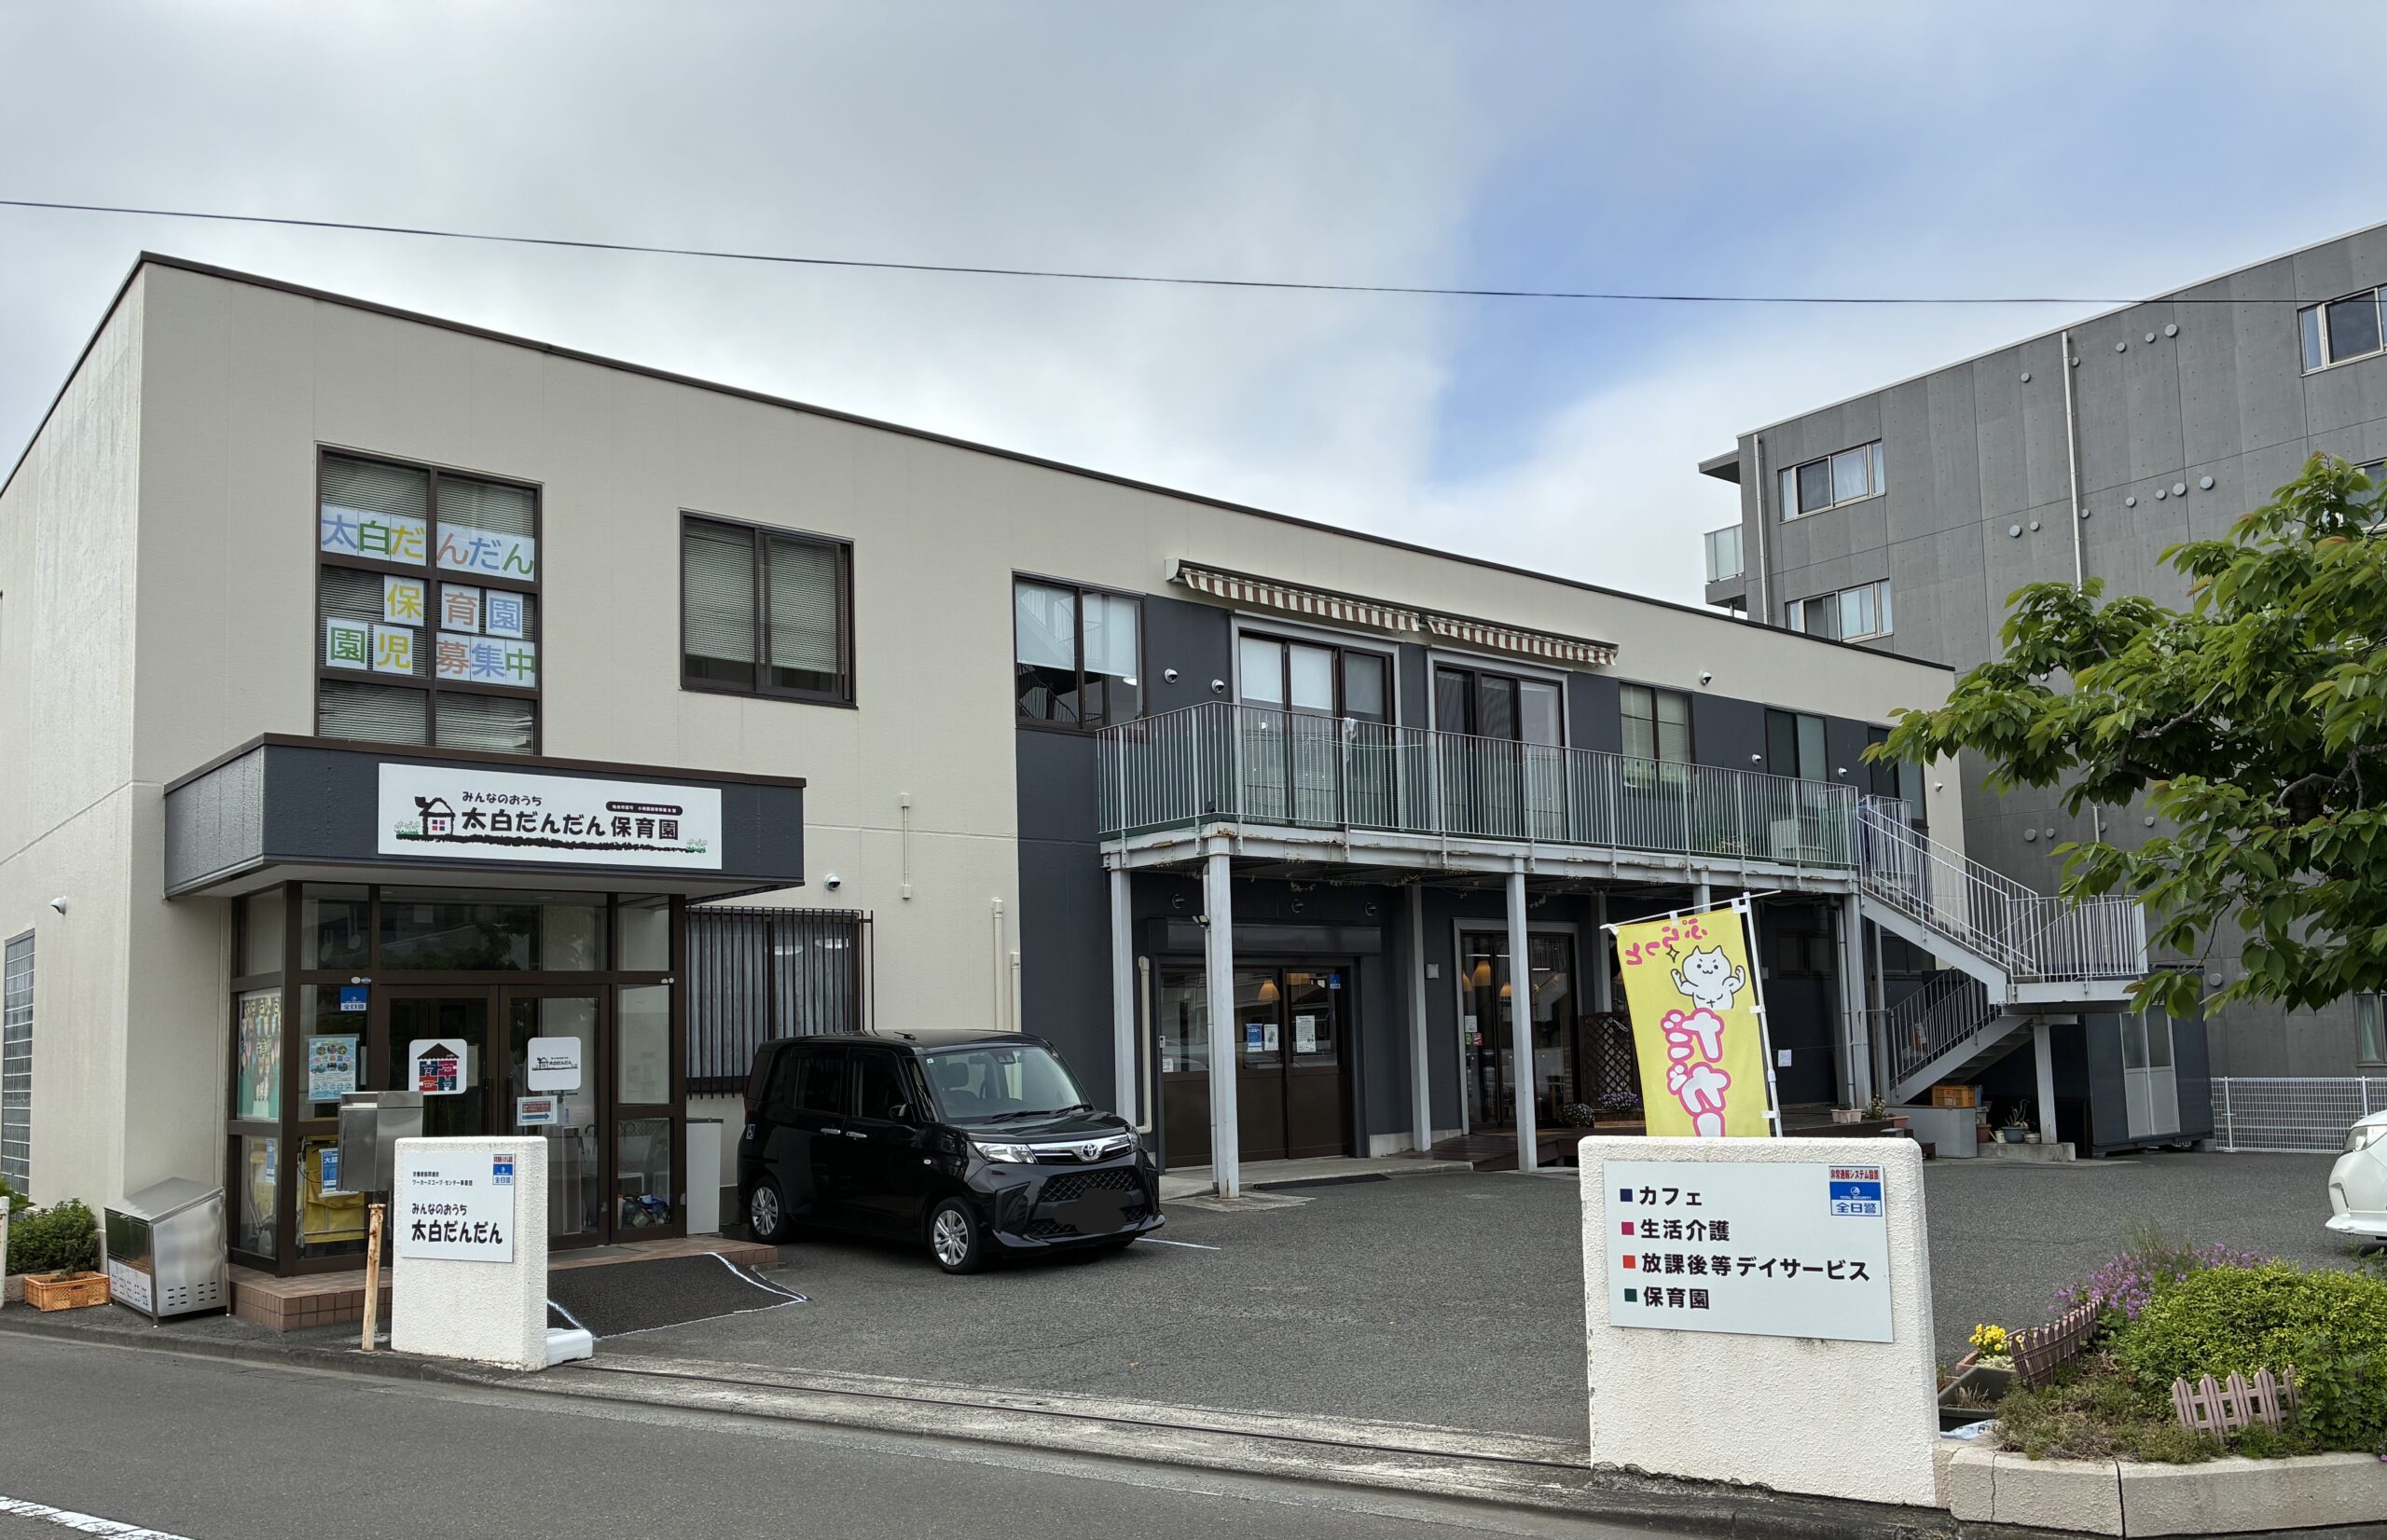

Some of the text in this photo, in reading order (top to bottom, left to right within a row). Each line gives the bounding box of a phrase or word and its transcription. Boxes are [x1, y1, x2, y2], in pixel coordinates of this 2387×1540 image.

[321, 514, 534, 575] 太白だんだん
[386, 581, 522, 633] 保育園
[330, 626, 535, 681] 園児募集中
[462, 791, 543, 807] みんなのおうち
[461, 806, 680, 841] 太白だんだん保育園
[1638, 1186, 1703, 1206] カフェ
[1836, 1203, 1876, 1214] 全日警
[411, 1203, 468, 1217] みんなのおうち
[411, 1218, 504, 1244] 太白だんだん
[1640, 1218, 1731, 1242] 生活介護
[1641, 1252, 1870, 1282] 放課後等デイサービス
[1643, 1286, 1710, 1310] 保育園
